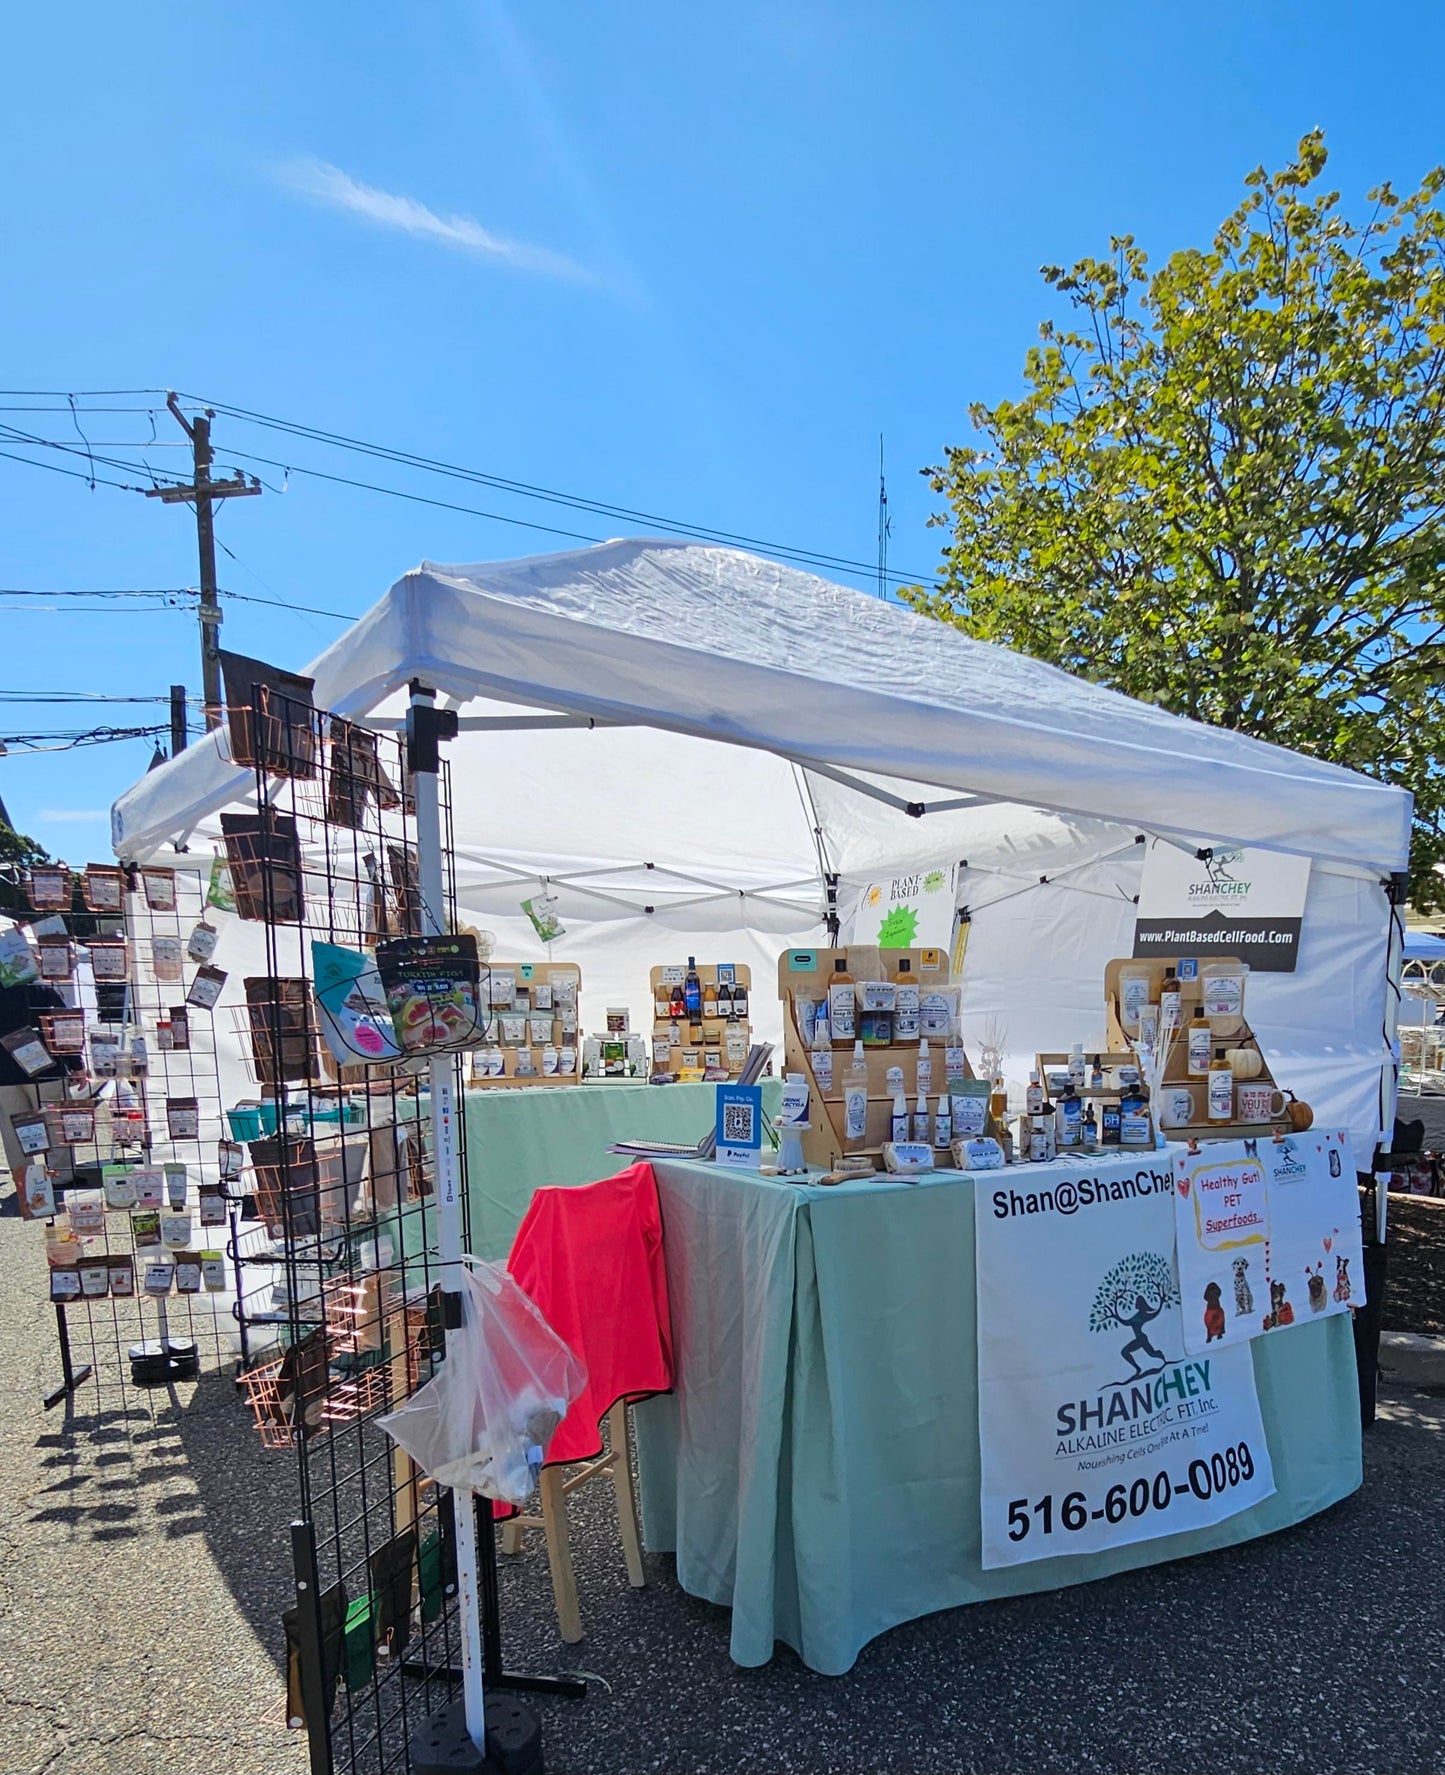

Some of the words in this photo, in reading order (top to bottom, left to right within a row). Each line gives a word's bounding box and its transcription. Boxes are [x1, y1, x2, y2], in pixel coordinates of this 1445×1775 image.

[890, 885, 919, 901] BASED
[1188, 882, 1252, 896] SHANCHEY
[1139, 930, 1293, 944] www.PlantBasedCellFood.Com
[398, 970, 437, 979] TURKISH
[1104, 1115, 1120, 1127] pH
[1273, 1164, 1307, 1178] SHANCHEY
[1201, 1174, 1239, 1192] Healthy
[1223, 1193, 1242, 1208] PET
[1056, 1359, 1212, 1437] SHANCHEY
[1055, 1427, 1126, 1456] ALKALINE
[1198, 1398, 1219, 1413] Inc.
[1077, 1452, 1126, 1472] Nourishing
[1126, 1447, 1146, 1461] Cells
[1169, 1431, 1180, 1442] At
[1181, 1428, 1190, 1440] A
[1007, 1441, 1255, 1542] 516-600-0089
